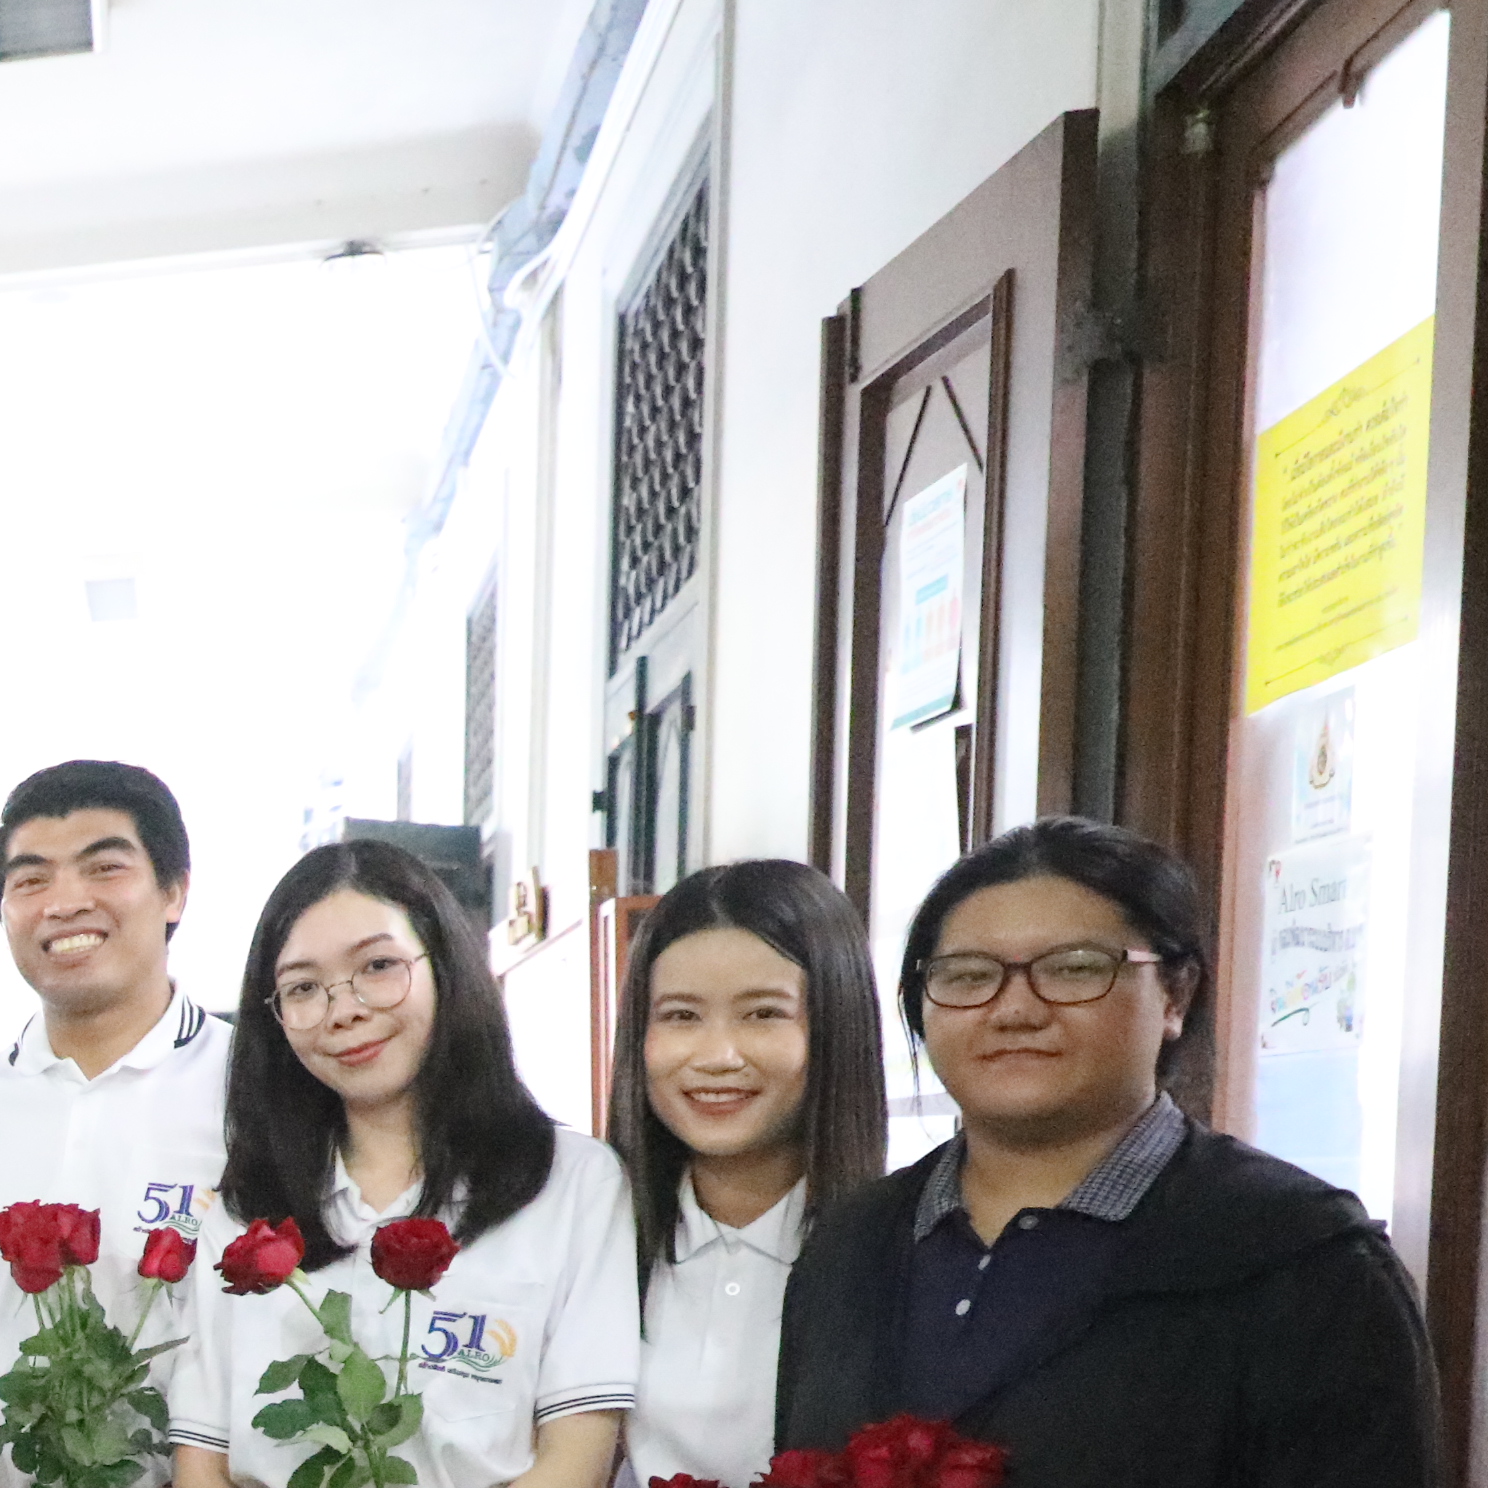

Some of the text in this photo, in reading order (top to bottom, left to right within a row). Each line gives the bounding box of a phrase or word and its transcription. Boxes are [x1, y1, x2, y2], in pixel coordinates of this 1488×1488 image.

[1308, 878, 1348, 908] Smar
[137, 1182, 195, 1224] 51
[169, 1214, 198, 1227] ALRO
[421, 1310, 487, 1358] 51
[457, 1349, 491, 1362] ALRO
